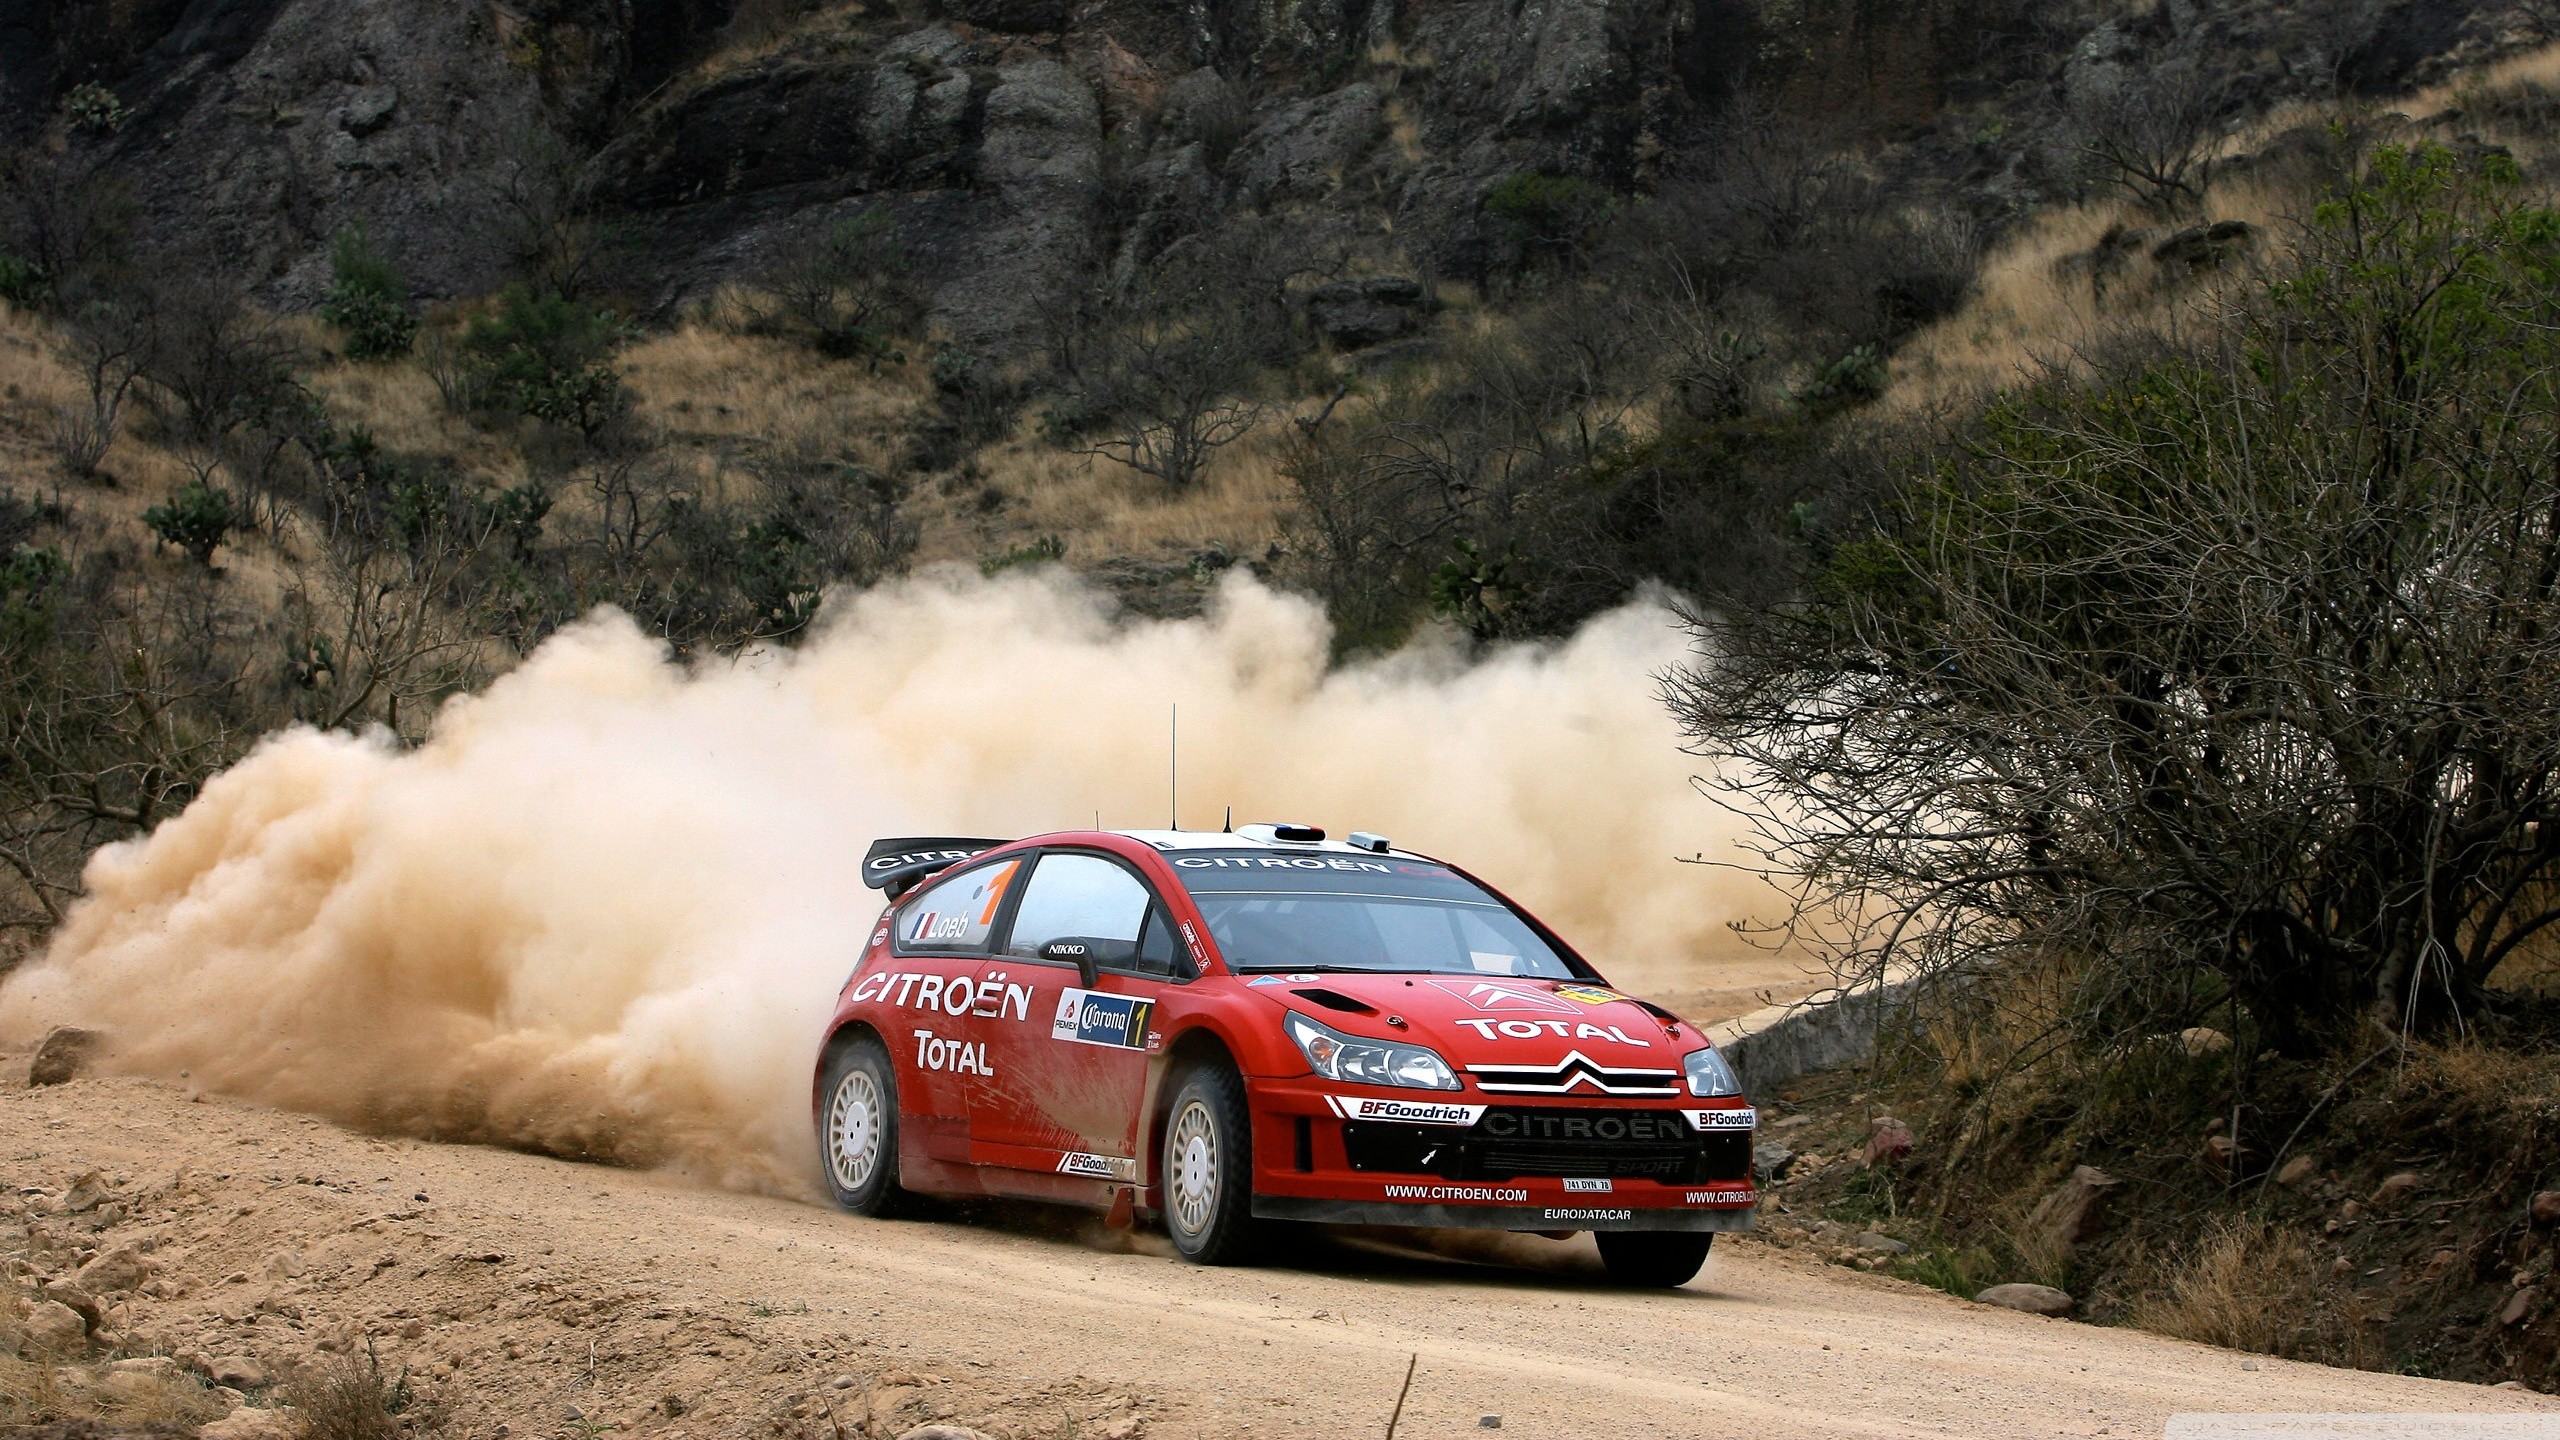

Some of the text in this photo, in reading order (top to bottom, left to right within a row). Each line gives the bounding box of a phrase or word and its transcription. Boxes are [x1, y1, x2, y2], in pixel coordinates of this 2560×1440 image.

[1175, 857, 1391, 874] CITROËN
[977, 859, 1022, 926] 1
[927, 910, 969, 939] Loeb
[1048, 944, 1085, 955] NIKKO
[852, 971, 1034, 1022] CITROËN
[1055, 1019, 1078, 1031] PEMEX
[1081, 1002, 1126, 1034] Corona
[1135, 1003, 1148, 1046] 1
[1455, 1018, 1651, 1047] TOTAL
[1359, 1100, 1470, 1120] BFGoodrich
[1699, 1112, 1753, 1125] BFGoodrich
[1483, 1112, 1684, 1140] CITROËN
[1614, 1160, 1686, 1174] SPORT
[1385, 1185, 1527, 1201] WWW.CITROEN.COM
[1566, 1180, 1580, 1189] 741
[1581, 1181, 1597, 1190] DYN
[1544, 1208, 1631, 1220] EURODATACAR
